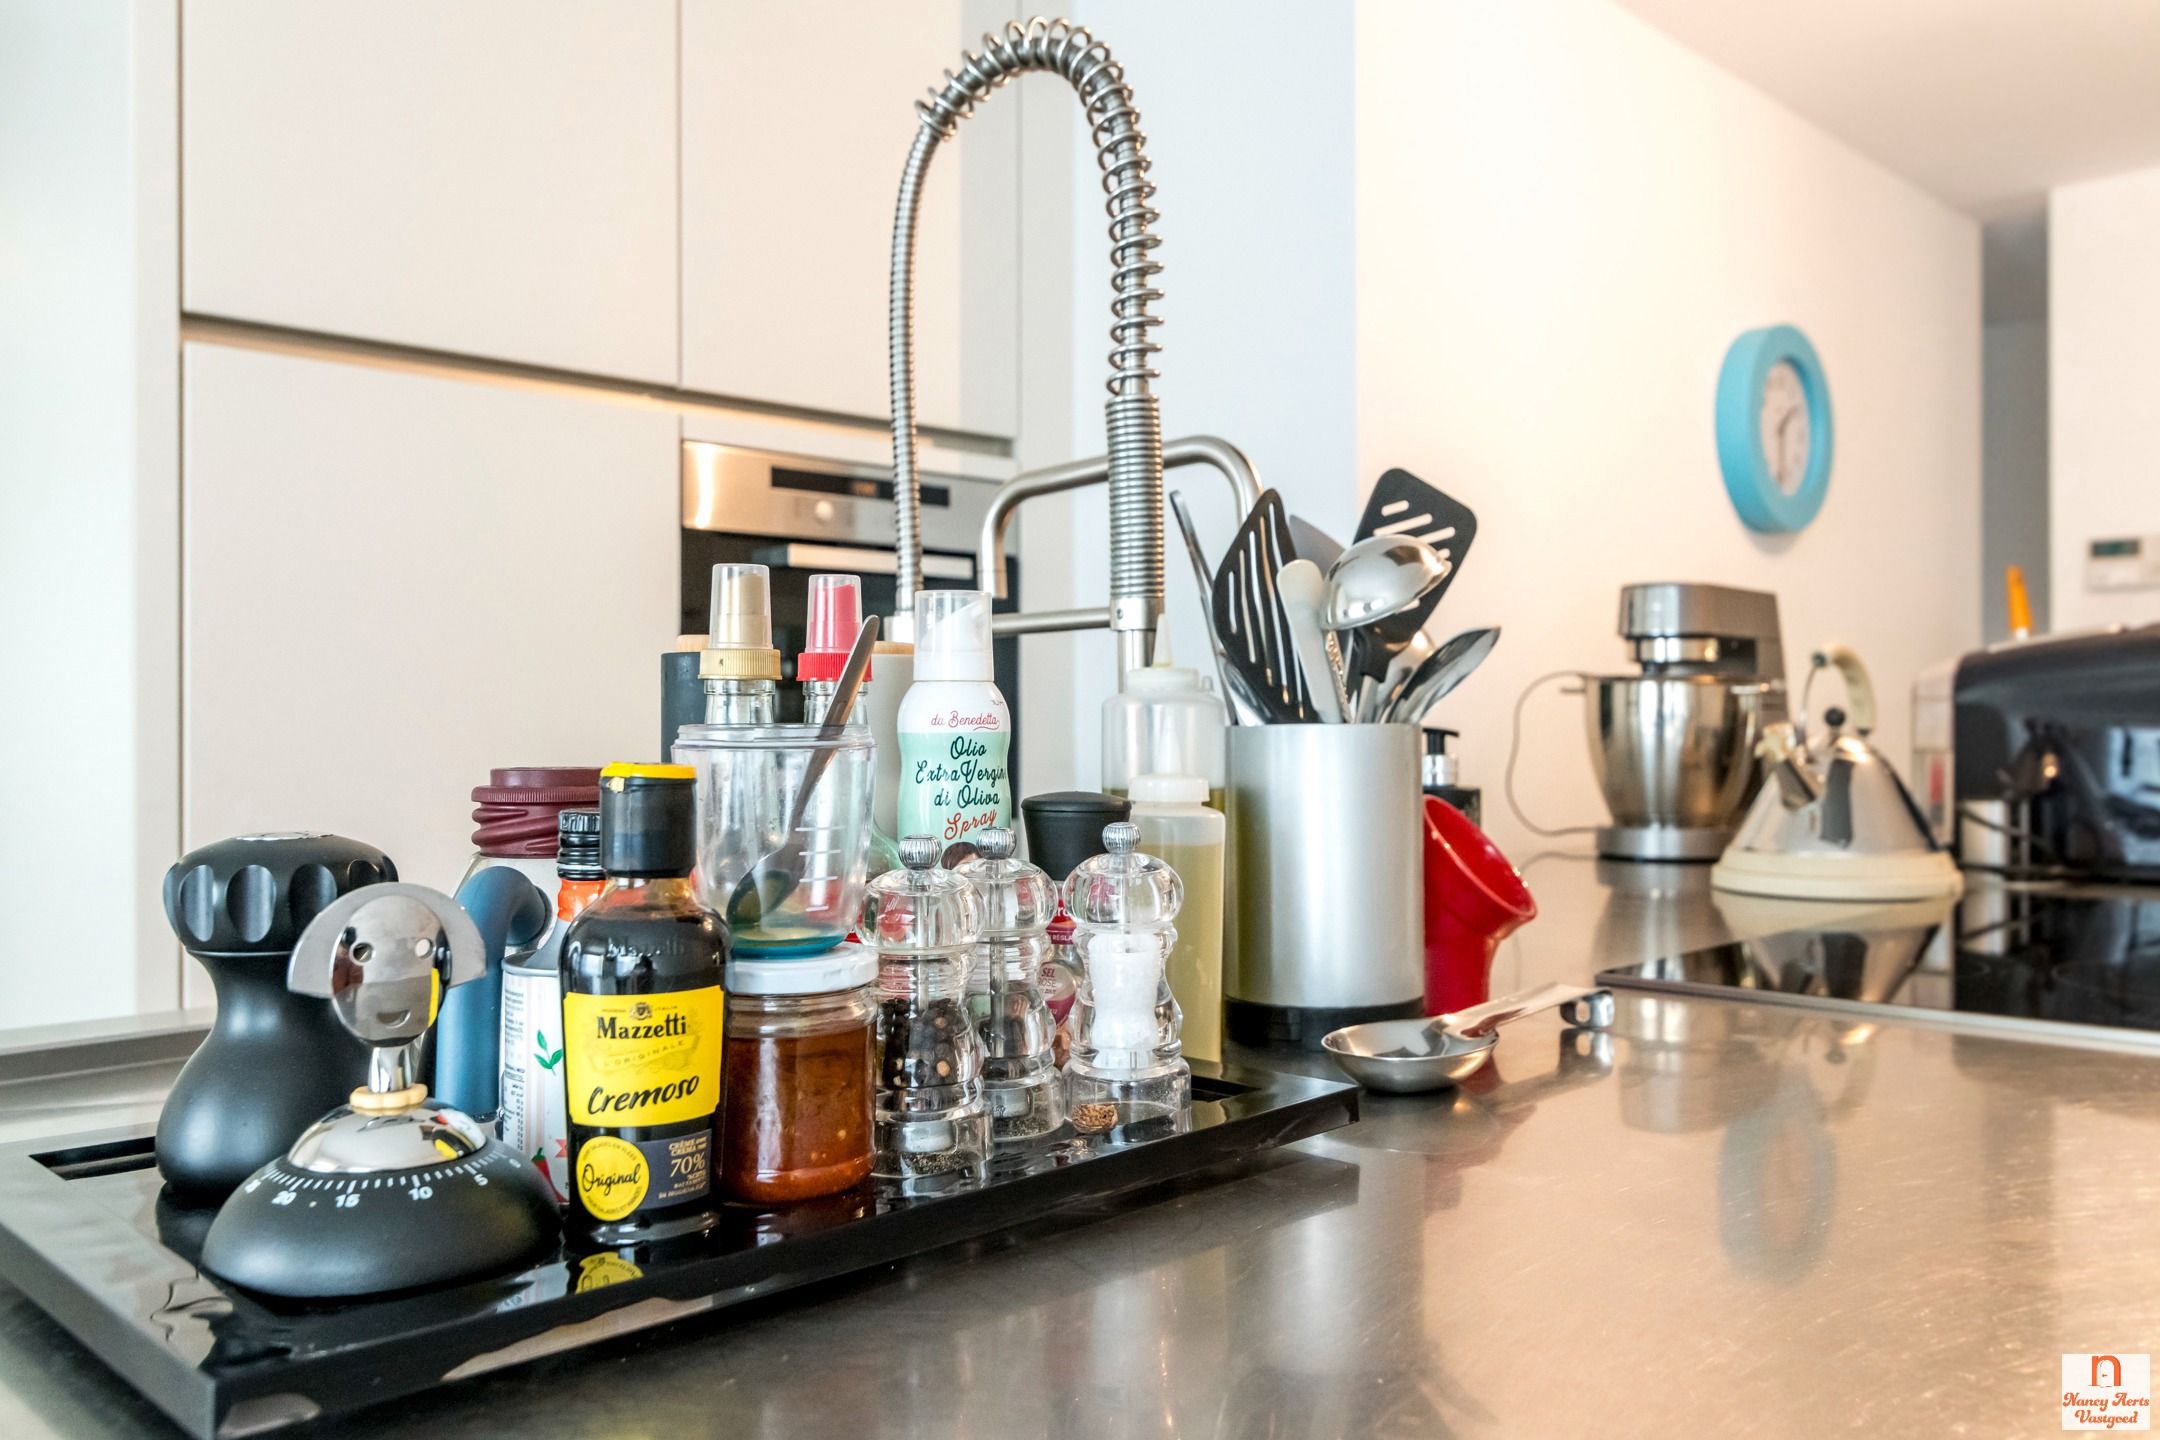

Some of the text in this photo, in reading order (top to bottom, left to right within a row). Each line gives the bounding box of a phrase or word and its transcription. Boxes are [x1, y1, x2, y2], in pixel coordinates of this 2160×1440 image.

[950, 735, 988, 760] Olio
[915, 760, 960, 784] Extra
[934, 784, 1001, 809] di Oliva
[944, 808, 998, 841] Spray
[596, 1012, 688, 1040] Mazzetti
[587, 1074, 700, 1116] Cremoso
[670, 1151, 705, 1178] 70%
[473, 1173, 489, 1186] 5
[582, 1163, 641, 1196] Original
[335, 1193, 361, 1209] 15
[408, 1186, 433, 1201] 10
